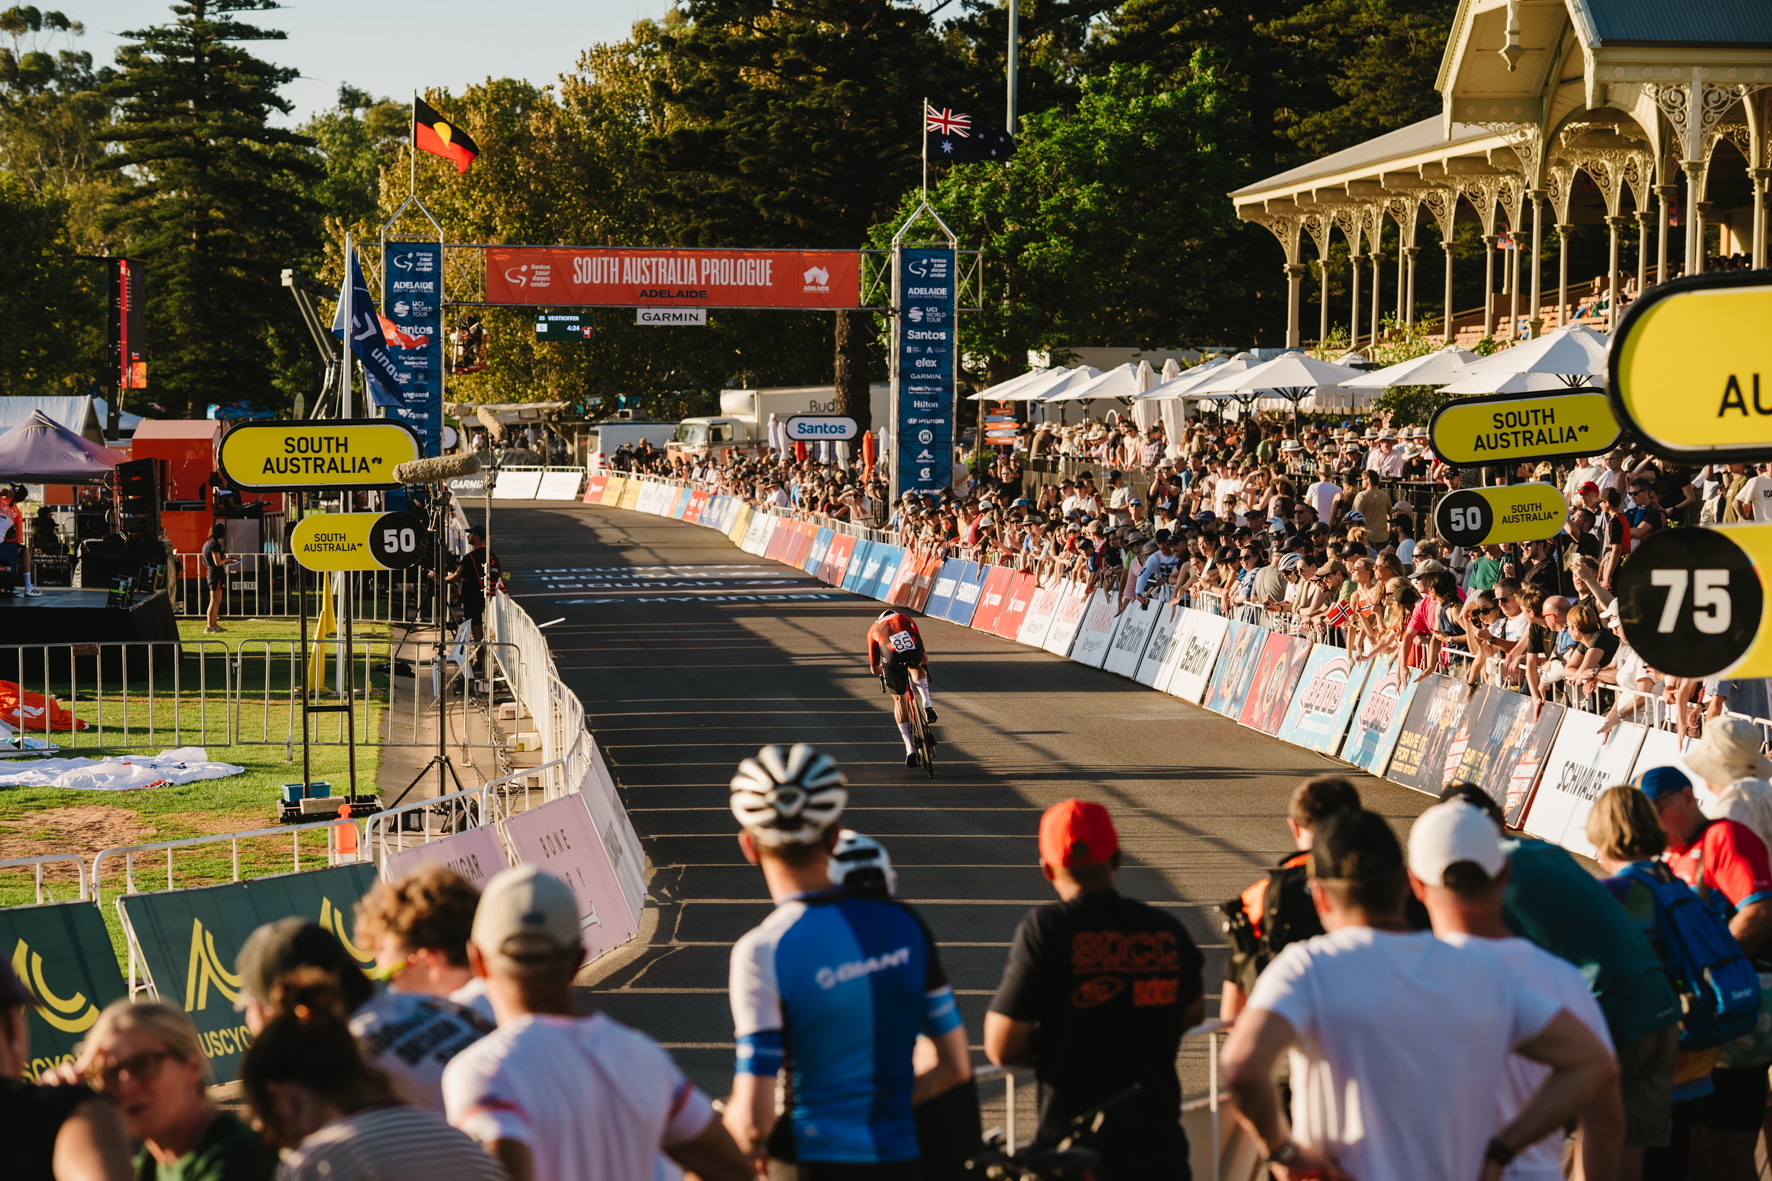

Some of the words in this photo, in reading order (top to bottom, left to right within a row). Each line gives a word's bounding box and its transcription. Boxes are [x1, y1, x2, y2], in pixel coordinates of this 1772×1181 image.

[573, 257, 619, 284] SOUTH
[622, 257, 697, 285] AUSTRALIA
[701, 258, 773, 286] PROLOGUE
[393, 281, 434, 289] ADELAIDE
[908, 287, 948, 295] ADELAIDE
[639, 289, 708, 299] ADELAIDE
[642, 312, 702, 322] GARMIN
[907, 330, 947, 340] Santos
[913, 400, 938, 408] Hilton
[1493, 408, 1555, 430] SOUTH
[797, 422, 846, 434] Santos
[284, 436, 348, 453] SOUTH
[1473, 425, 1578, 451] AUSTRALIA
[262, 456, 370, 474] AUSTRALIA
[1511, 503, 1542, 514] SOUTH
[1450, 506, 1482, 532] 50
[1501, 511, 1554, 524] AUSTRALIA
[314, 533, 346, 542] SOUTH
[383, 527, 416, 553] 50
[303, 542, 357, 552] AUSTRALIA
[547, 580, 722, 588] HYUNDAI
[637, 593, 831, 603] HYUNDAI
[1651, 569, 1731, 634] 75
[893, 636, 913, 650] 85
[1401, 729, 1421, 749] SAVE
[1395, 745, 1409, 762] FOR
[1409, 750, 1422, 766] THE
[1461, 747, 1483, 768] SAVE
[1456, 763, 1471, 781] FOR
[1556, 760, 1607, 803] SCHWALBE
[539, 828, 571, 859] BONE
